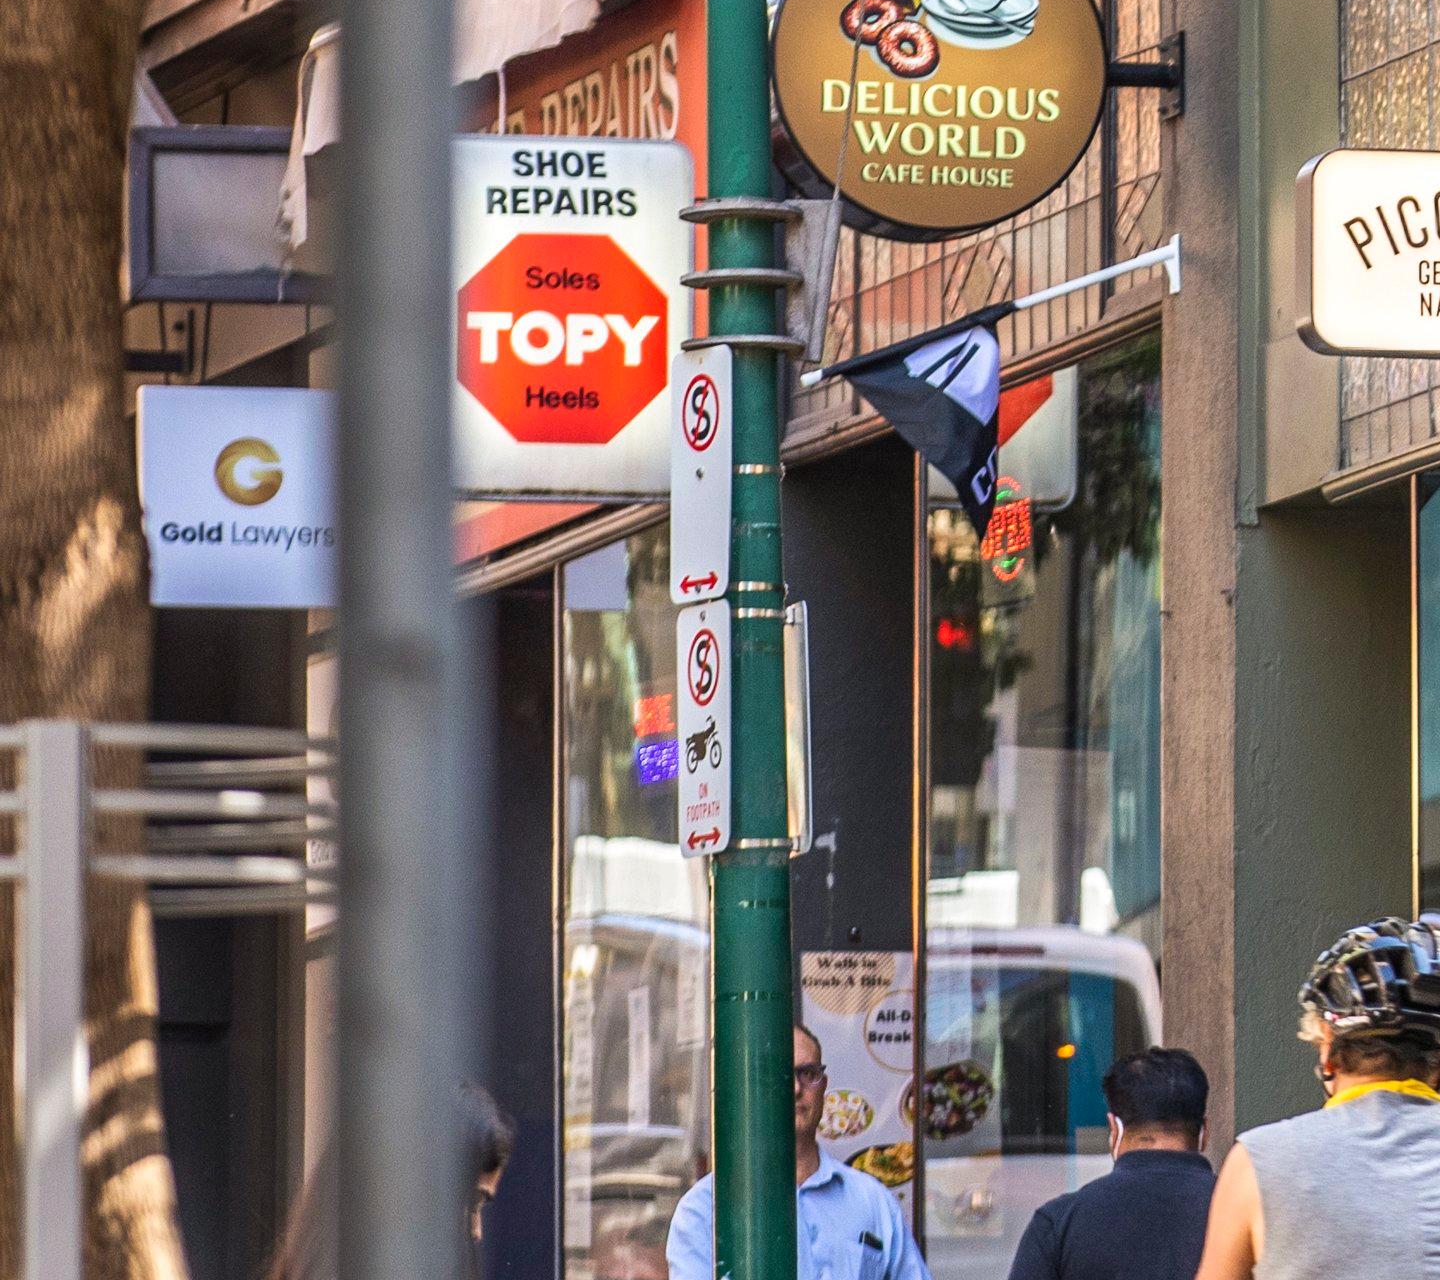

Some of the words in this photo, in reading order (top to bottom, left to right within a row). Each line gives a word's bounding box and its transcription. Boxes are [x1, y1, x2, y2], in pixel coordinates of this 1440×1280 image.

[820, 78, 1061, 123] DELICIOUS
[852, 120, 1027, 160] WORLD
[512, 149, 607, 179] SHOE
[861, 162, 926, 184] CAFE
[931, 165, 1015, 188] HOUSE
[486, 186, 638, 217] REPAIRS
[525, 265, 601, 290] Soles
[466, 309, 660, 367] TOPY
[524, 385, 601, 410] Heels
[159, 521, 224, 545] Gold
[230, 519, 336, 553] Lawyers
[698, 782, 709, 800] ON
[686, 800, 721, 824] FOOTPATH
[876, 1008, 912, 1023] All-D
[867, 1029, 912, 1043] Break
